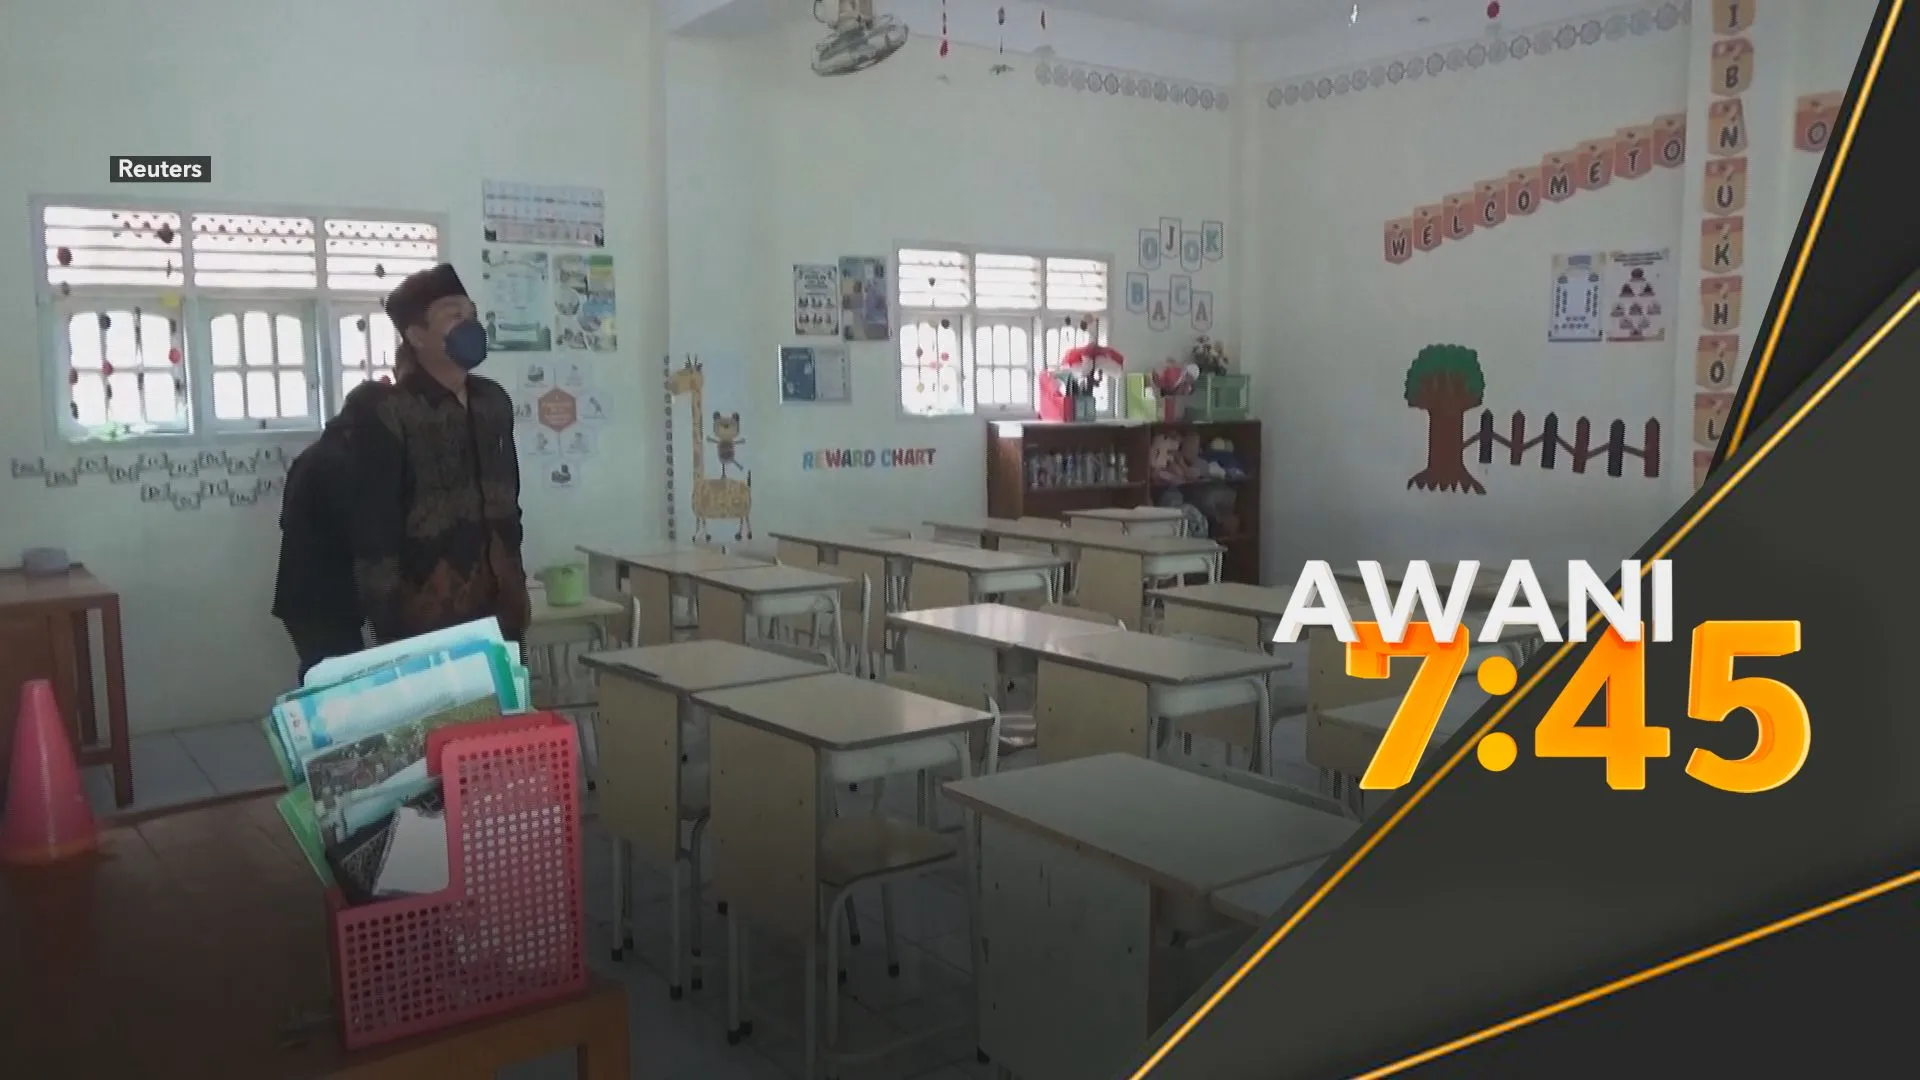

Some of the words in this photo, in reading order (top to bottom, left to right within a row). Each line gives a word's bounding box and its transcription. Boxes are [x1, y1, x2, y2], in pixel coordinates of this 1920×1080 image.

[1130, 281, 1209, 321] BACA
[802, 448, 876, 471] REWARD
[881, 448, 936, 468] CHART
